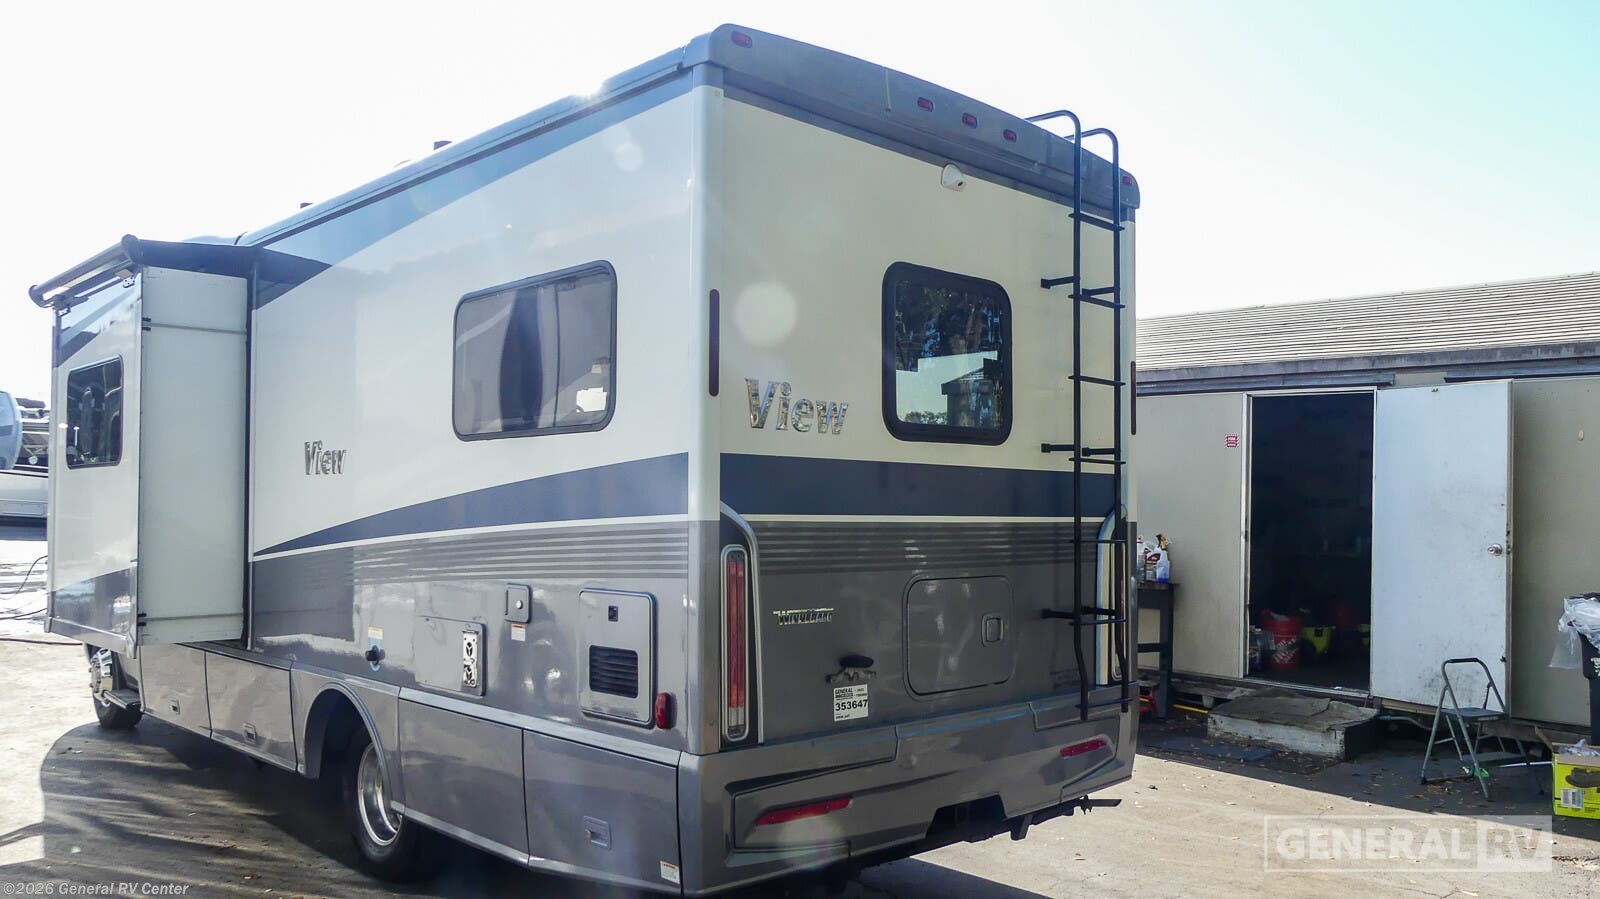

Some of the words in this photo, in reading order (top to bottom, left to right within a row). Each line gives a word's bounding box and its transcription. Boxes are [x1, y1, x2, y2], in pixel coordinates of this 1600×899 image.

[744, 377, 848, 435] View
[304, 440, 347, 475] View
[835, 699, 868, 711] 353647
